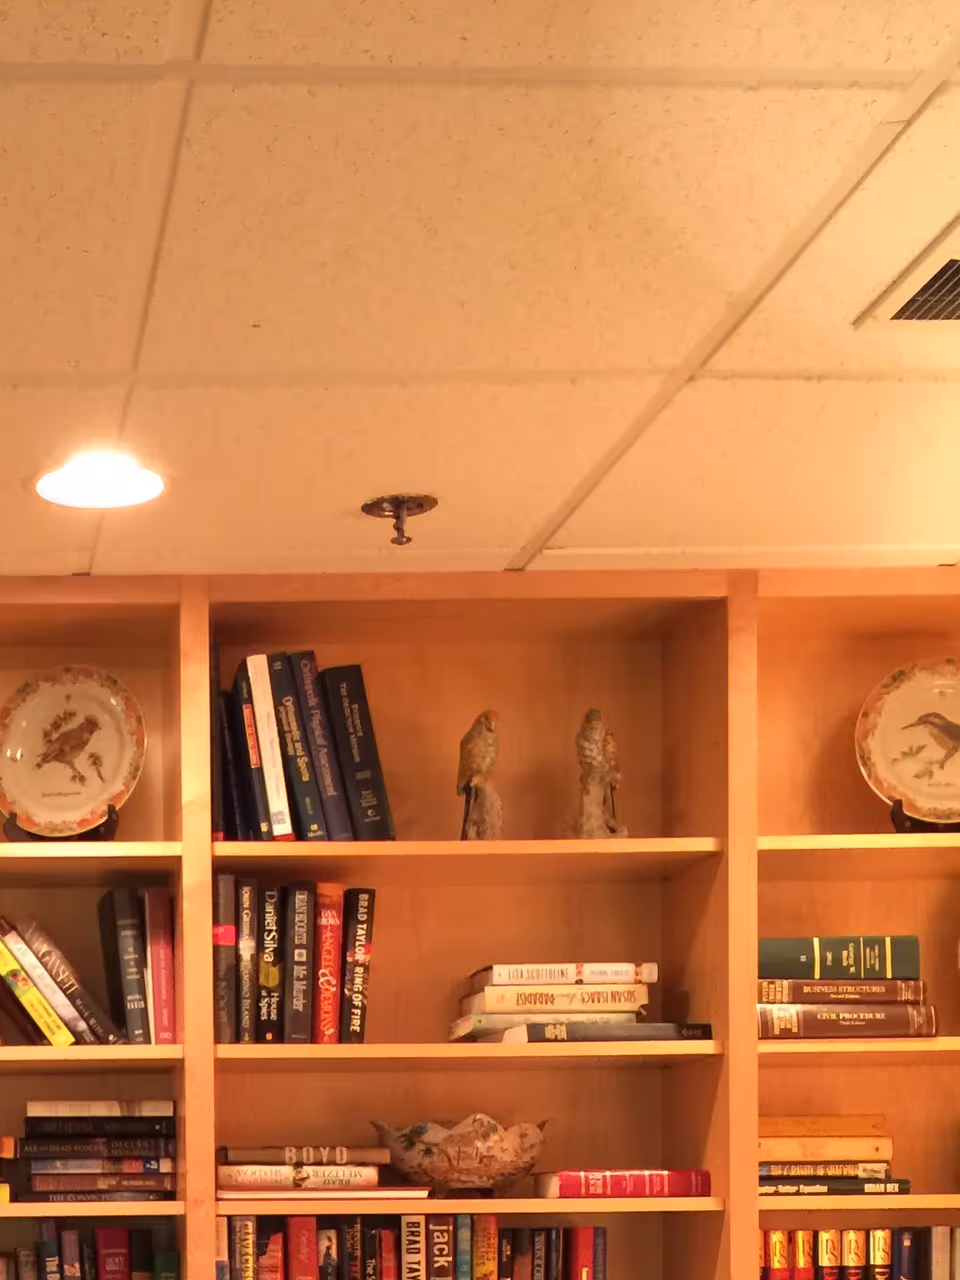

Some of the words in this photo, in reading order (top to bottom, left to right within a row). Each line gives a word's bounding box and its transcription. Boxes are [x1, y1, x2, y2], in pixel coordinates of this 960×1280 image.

[265, 891, 277, 930] Daniel
[357, 894, 369, 920] BRAD
[263, 932, 277, 962] Silva
[354, 924, 367, 964] TAYLOR
[353, 967, 364, 992] RING
[270, 992, 279, 1020] House
[352, 993, 362, 1007] OF
[350, 1009, 361, 1033] FIRE
[840, 1012, 887, 1020] PROCEDURE
[285, 1146, 348, 1165] BOYD
[241, 1221, 253, 1255] CLIVE
[406, 1221, 421, 1255] BRAD
[429, 1224, 452, 1268] jack
[46, 1256, 58, 1272] The
[366, 1258, 375, 1274] The
